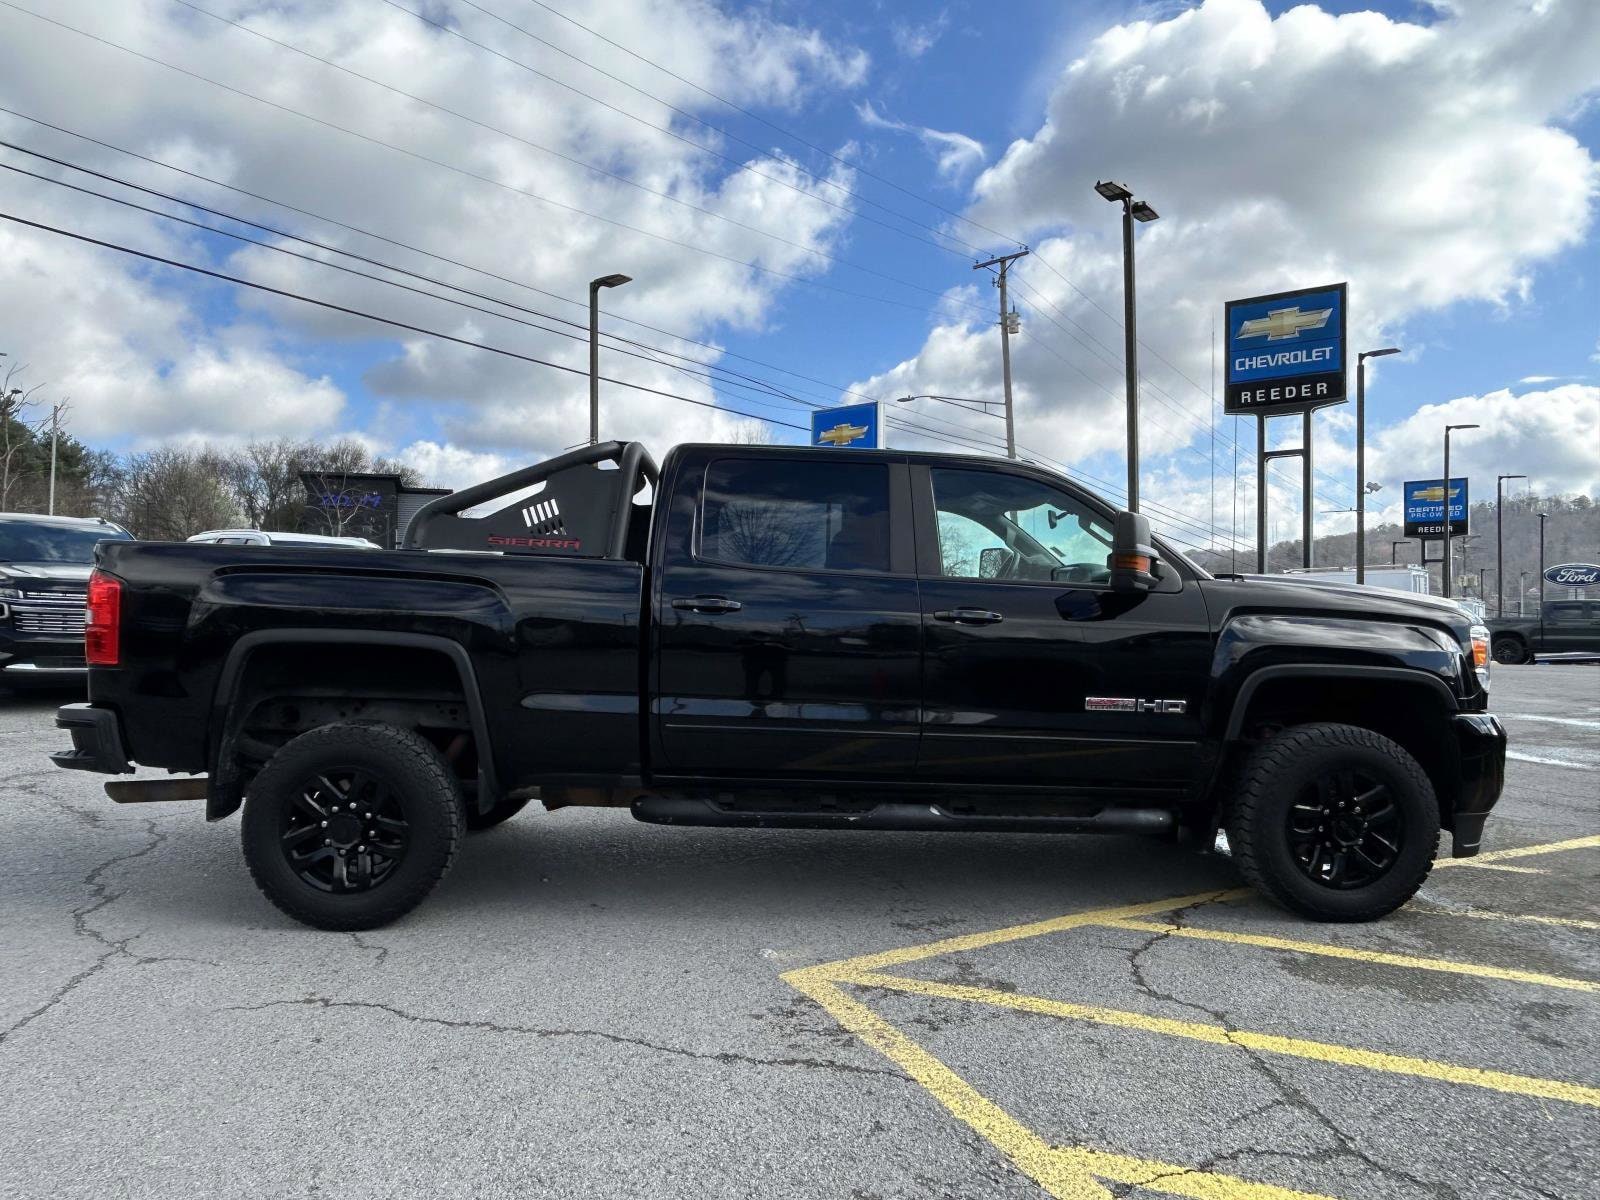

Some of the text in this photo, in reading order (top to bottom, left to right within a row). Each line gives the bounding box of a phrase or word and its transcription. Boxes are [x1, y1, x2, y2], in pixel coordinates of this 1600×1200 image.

[1235, 347, 1333, 370] CHEVROLET
[1241, 382, 1328, 403] REEDER
[1408, 505, 1463, 513] CERTIFED
[1411, 510, 1460, 518] PRE-OWED
[1418, 525, 1453, 533] REEDR
[488, 536, 581, 551] SIERRA
[1556, 568, 1598, 582] Ford
[1137, 698, 1187, 713] HD
